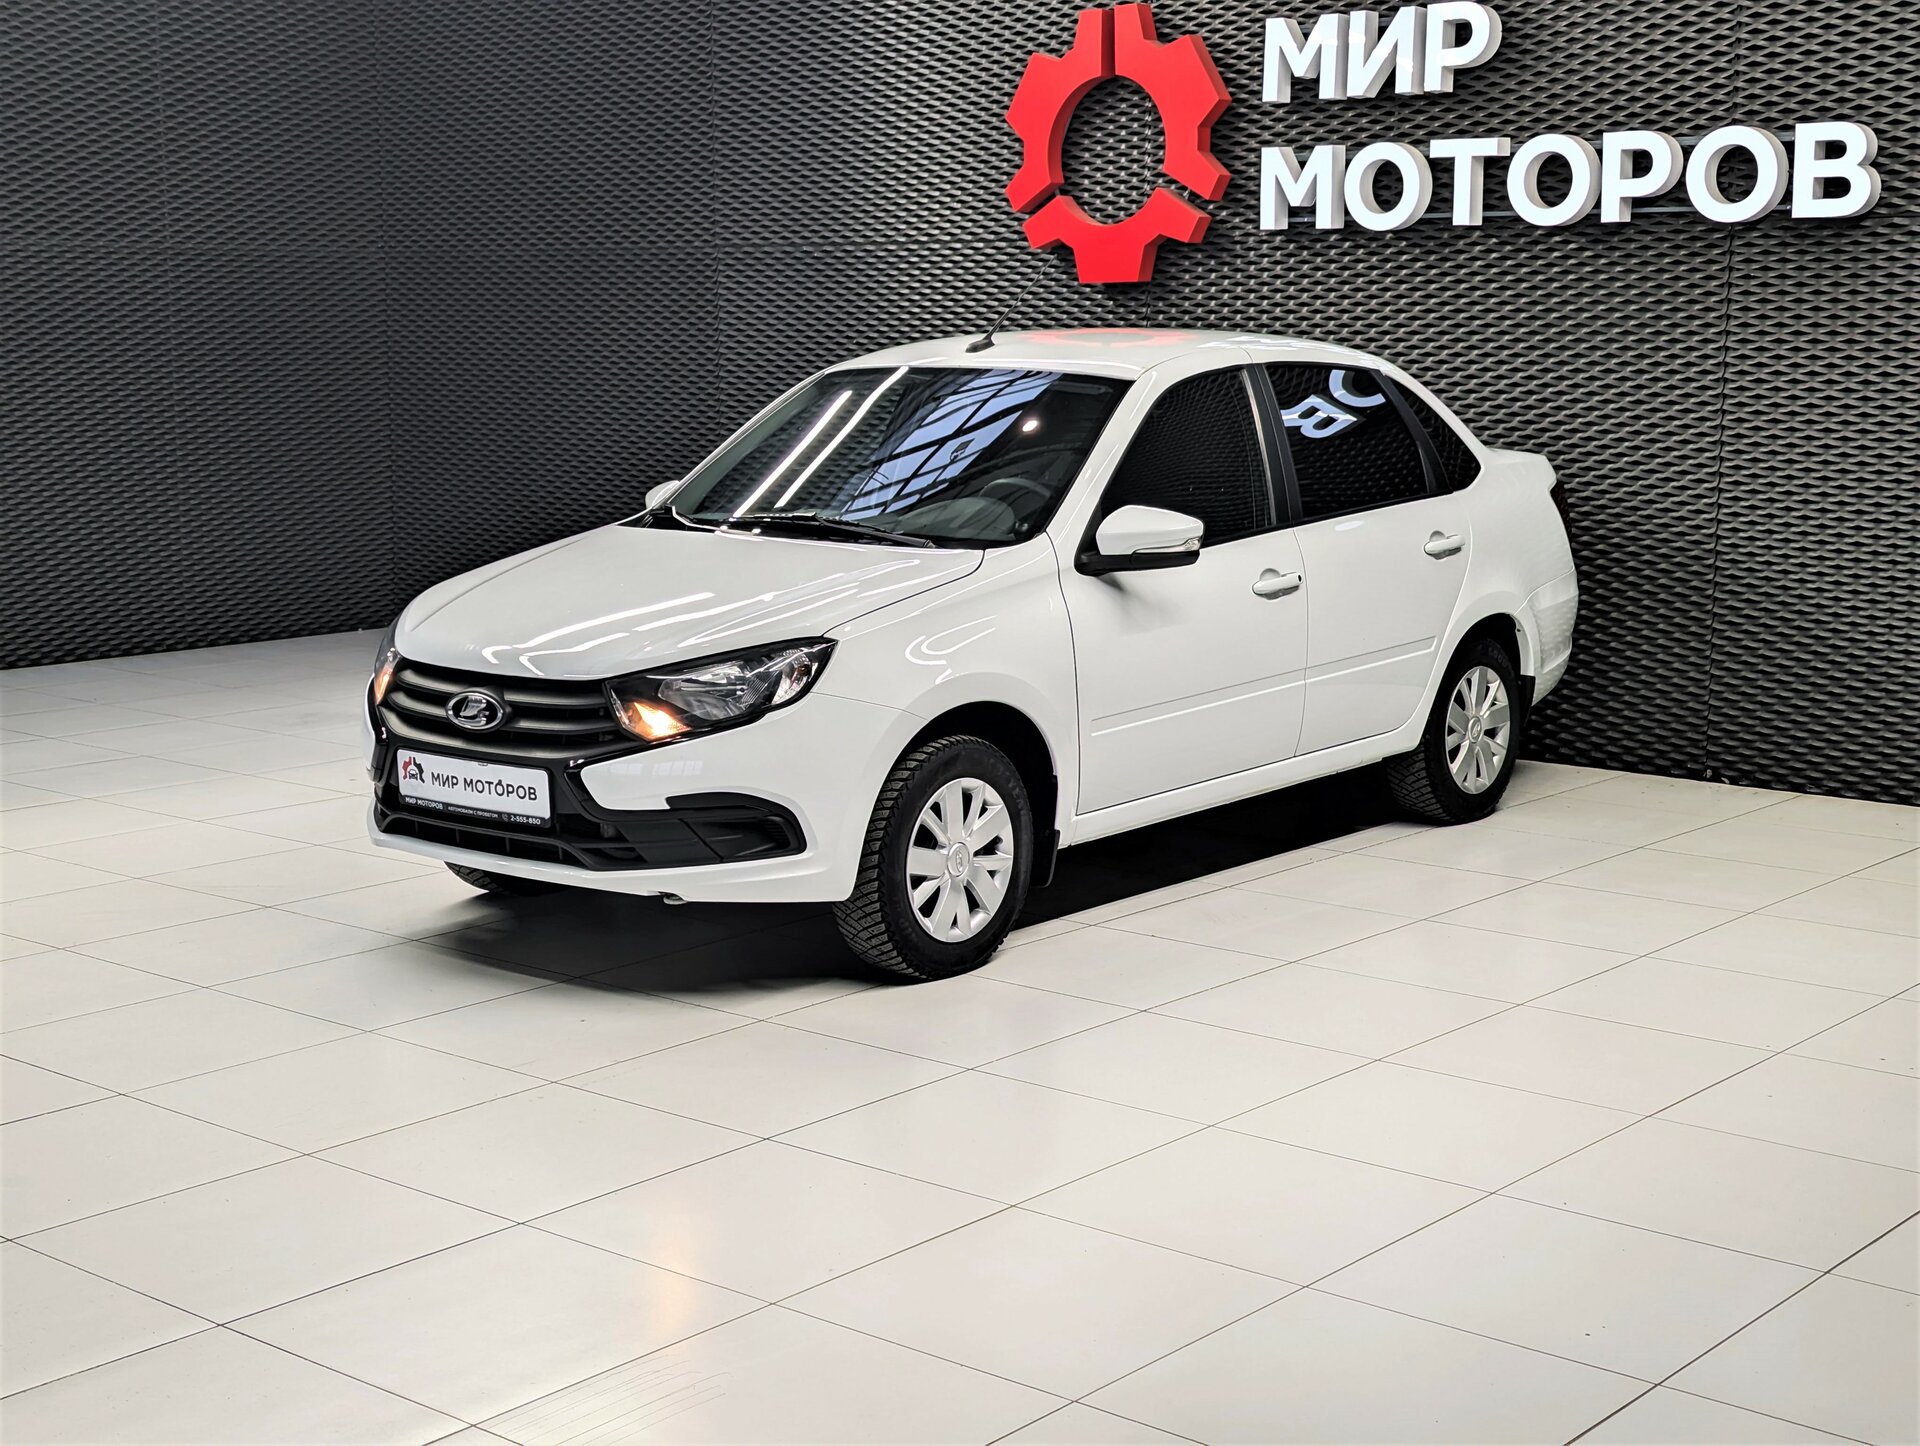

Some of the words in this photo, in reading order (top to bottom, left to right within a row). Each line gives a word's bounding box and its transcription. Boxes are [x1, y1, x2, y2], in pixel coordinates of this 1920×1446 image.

[1262, 1, 1502, 102] МИР
[1259, 121, 1882, 231] МОТОРОВ
[417, 800, 443, 810] МОТОРОВ
[431, 771, 459, 789] МИР
